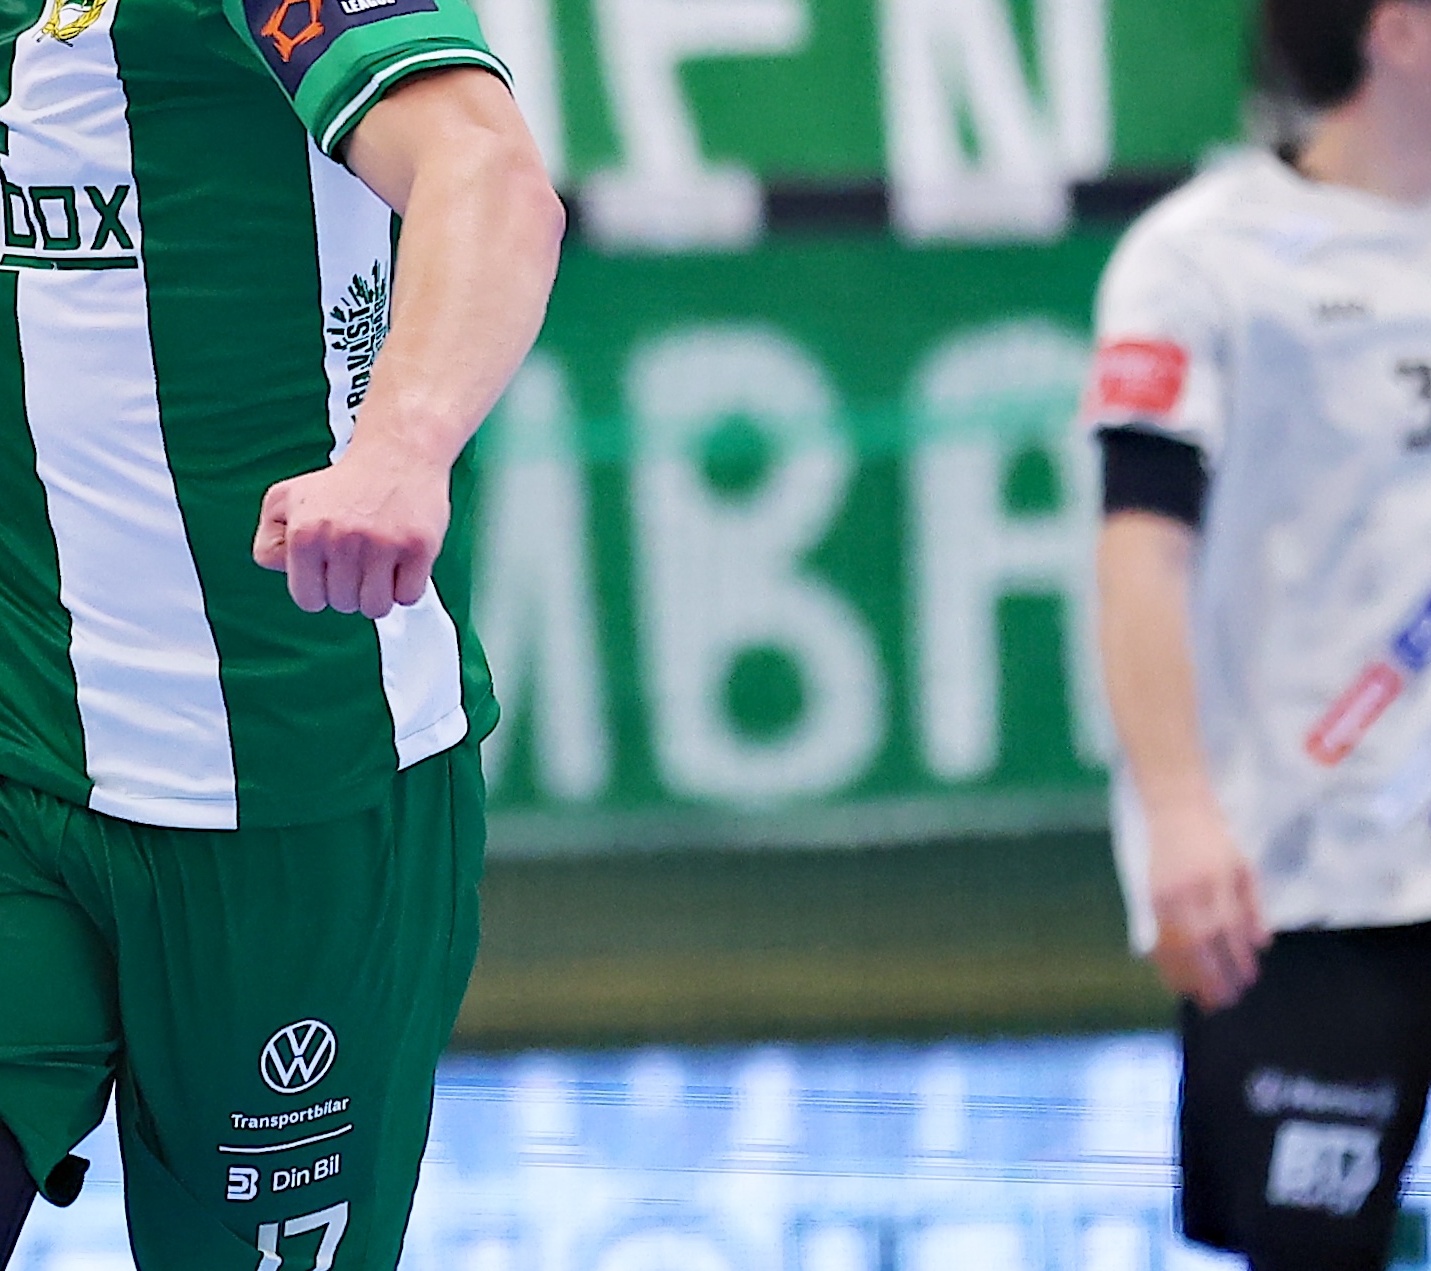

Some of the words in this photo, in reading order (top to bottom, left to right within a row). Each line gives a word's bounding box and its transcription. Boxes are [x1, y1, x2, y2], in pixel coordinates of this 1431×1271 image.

[231, 1098, 349, 1129] Transportbilar
[272, 1168, 310, 1191] Din
[313, 1153, 340, 1180] Bil
